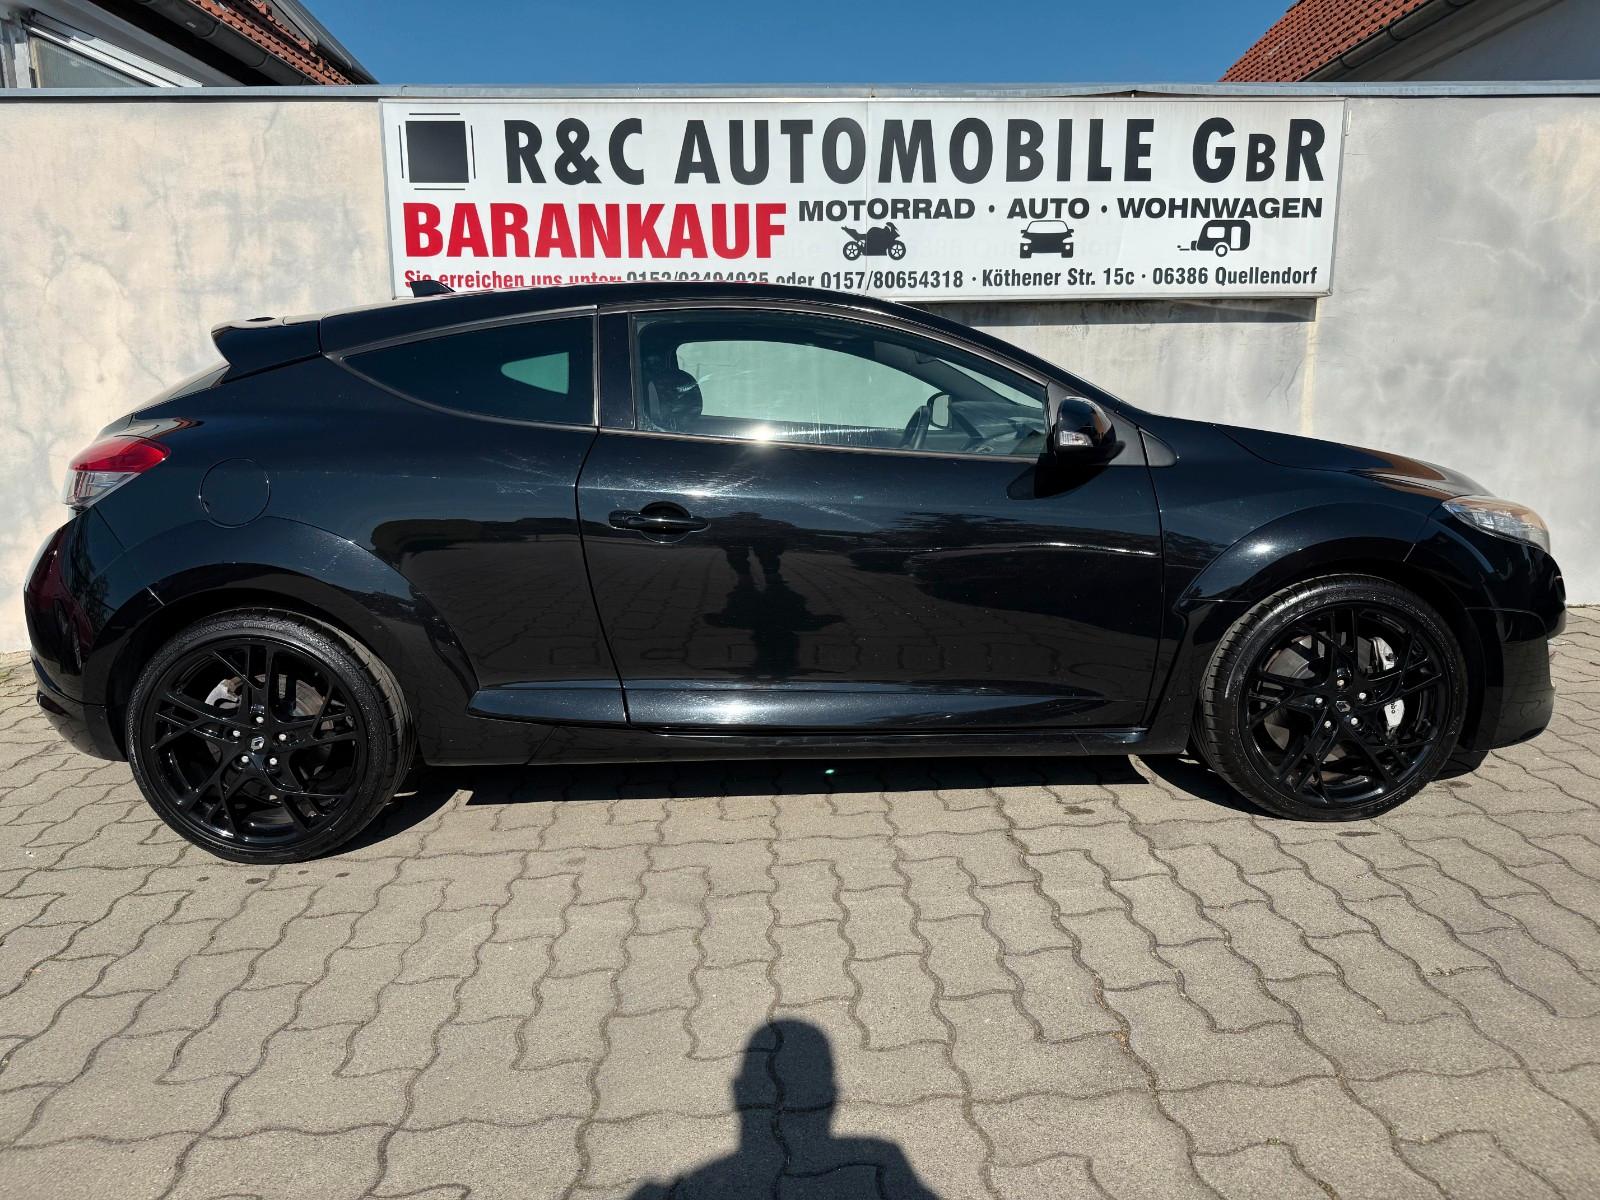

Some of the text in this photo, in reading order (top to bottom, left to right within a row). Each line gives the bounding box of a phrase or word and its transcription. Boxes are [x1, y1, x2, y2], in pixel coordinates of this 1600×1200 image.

[504, 118, 645, 186] R&C
[675, 118, 1155, 186] AUTOMOBILE
[799, 197, 1323, 222] MOTORRAD AUTO WOHNWAGEN
[402, 202, 787, 260] BARANKAUF
[439, 270, 524, 288] erreichen
[820, 270, 964, 290] 0157/80654318
[983, 269, 1061, 287] Köthener
[1067, 267, 1095, 286] Str.
[1103, 267, 1135, 286] 15c
[1153, 267, 1209, 285] 06386
[1215, 266, 1318, 287] Quellendorf
